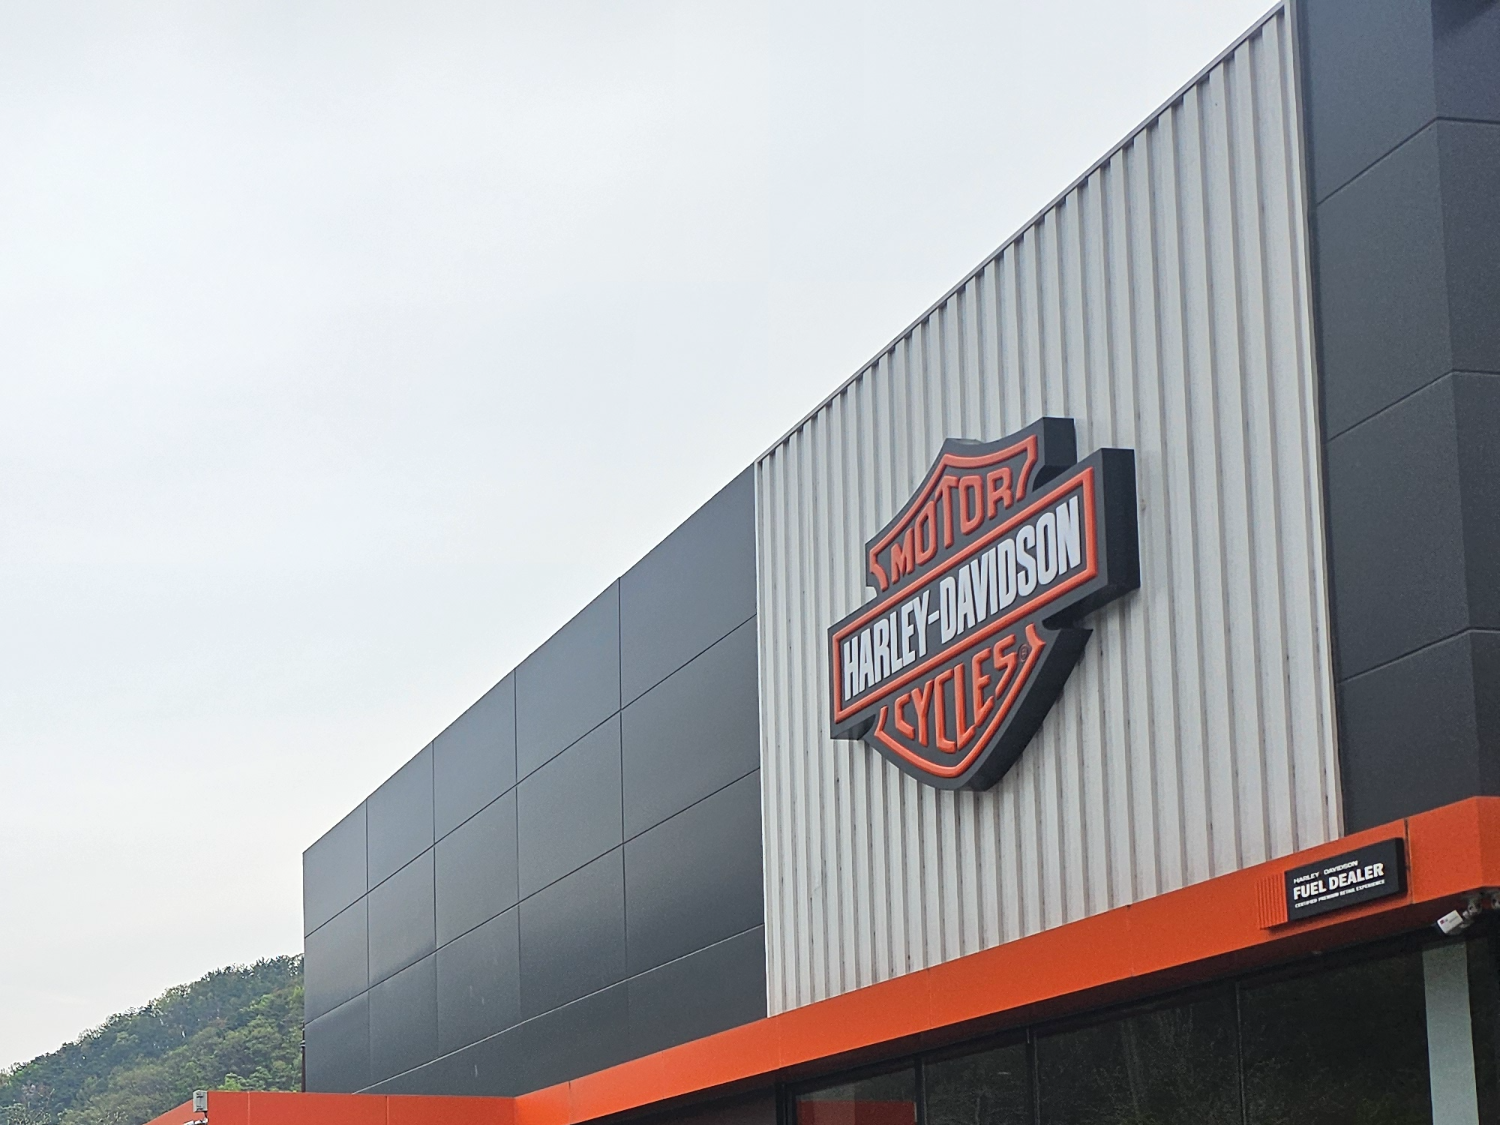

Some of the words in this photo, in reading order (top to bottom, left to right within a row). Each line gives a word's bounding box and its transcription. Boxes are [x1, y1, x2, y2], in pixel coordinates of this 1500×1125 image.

[890, 466, 1013, 583] MOTOR
[843, 495, 1082, 702] HARLEY-DAVIDSON
[894, 634, 1017, 754] CYCLES
[1293, 880, 1327, 900] FUEL
[1328, 862, 1385, 890] DEALER
[1294, 872, 1320, 884] HARLEY
[1324, 860, 1358, 874] DAVIDSON
